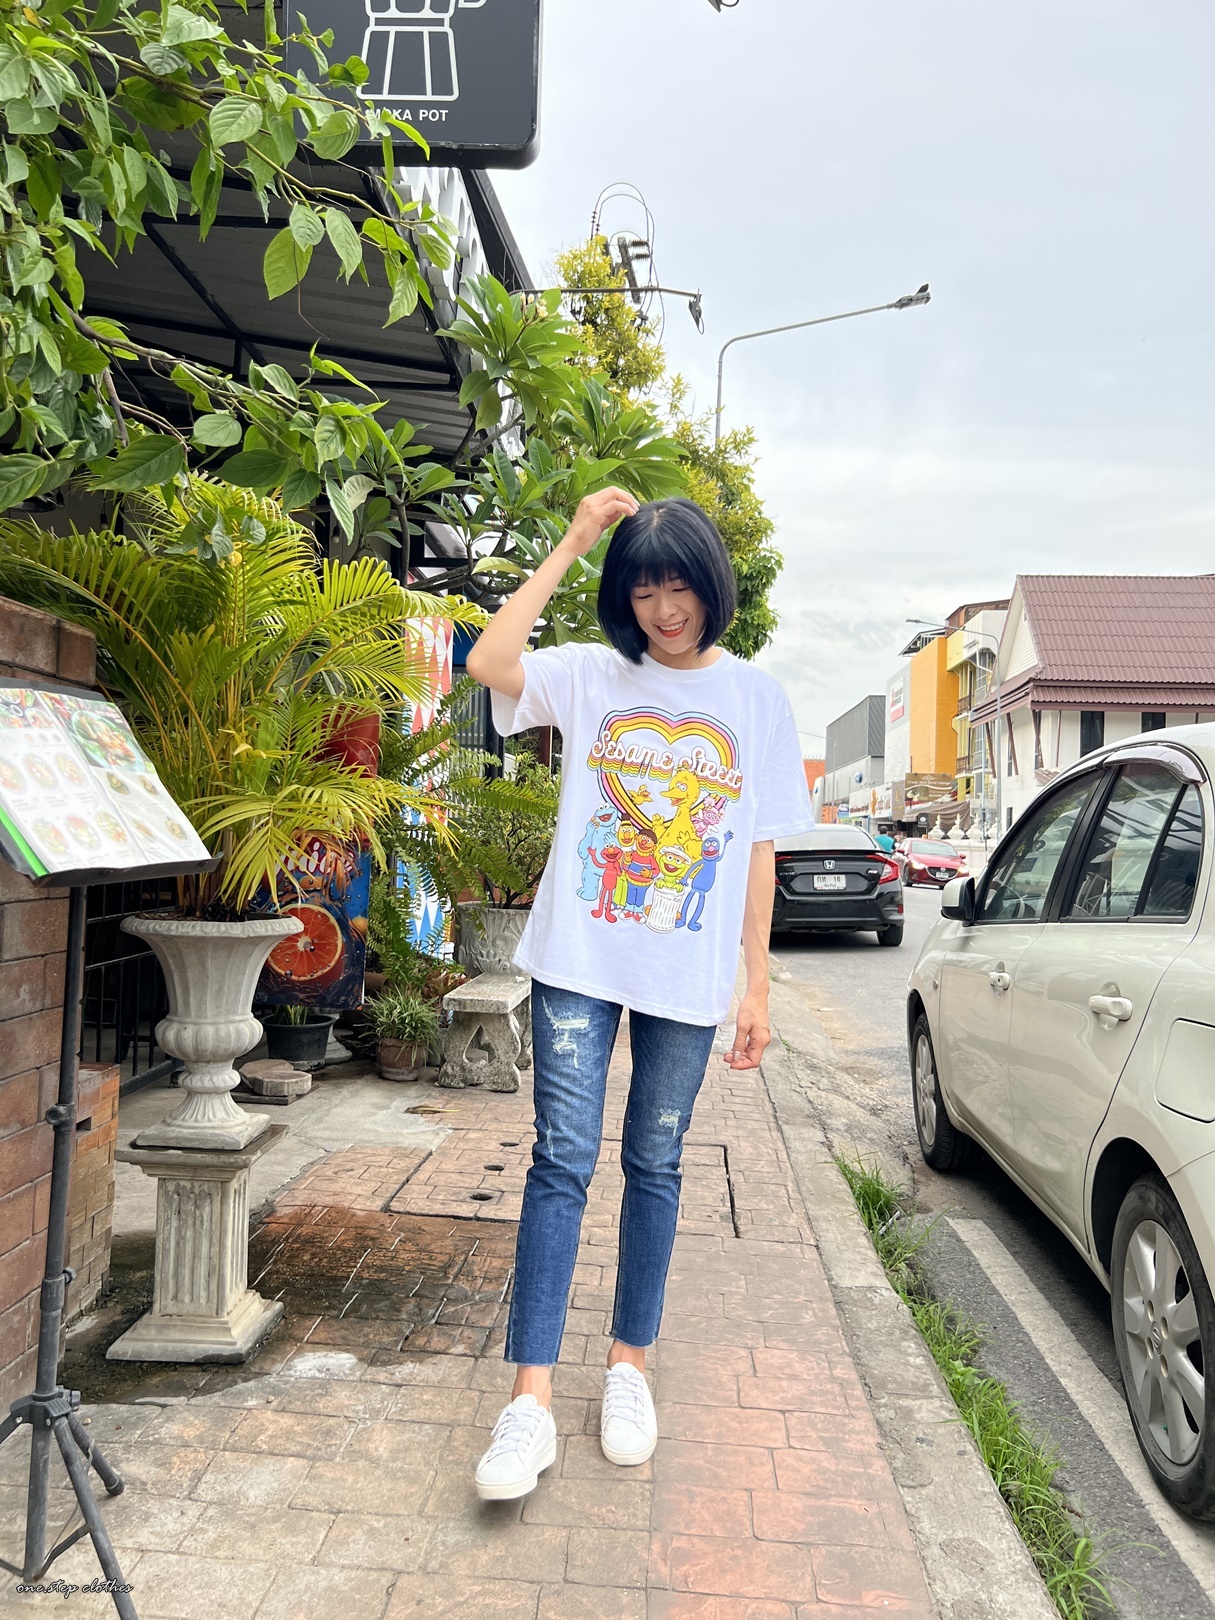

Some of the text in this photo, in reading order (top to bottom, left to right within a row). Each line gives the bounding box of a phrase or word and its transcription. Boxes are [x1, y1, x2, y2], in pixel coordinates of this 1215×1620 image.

[365, 108, 449, 122] MKA POT
[589, 730, 743, 794] Sesame Street
